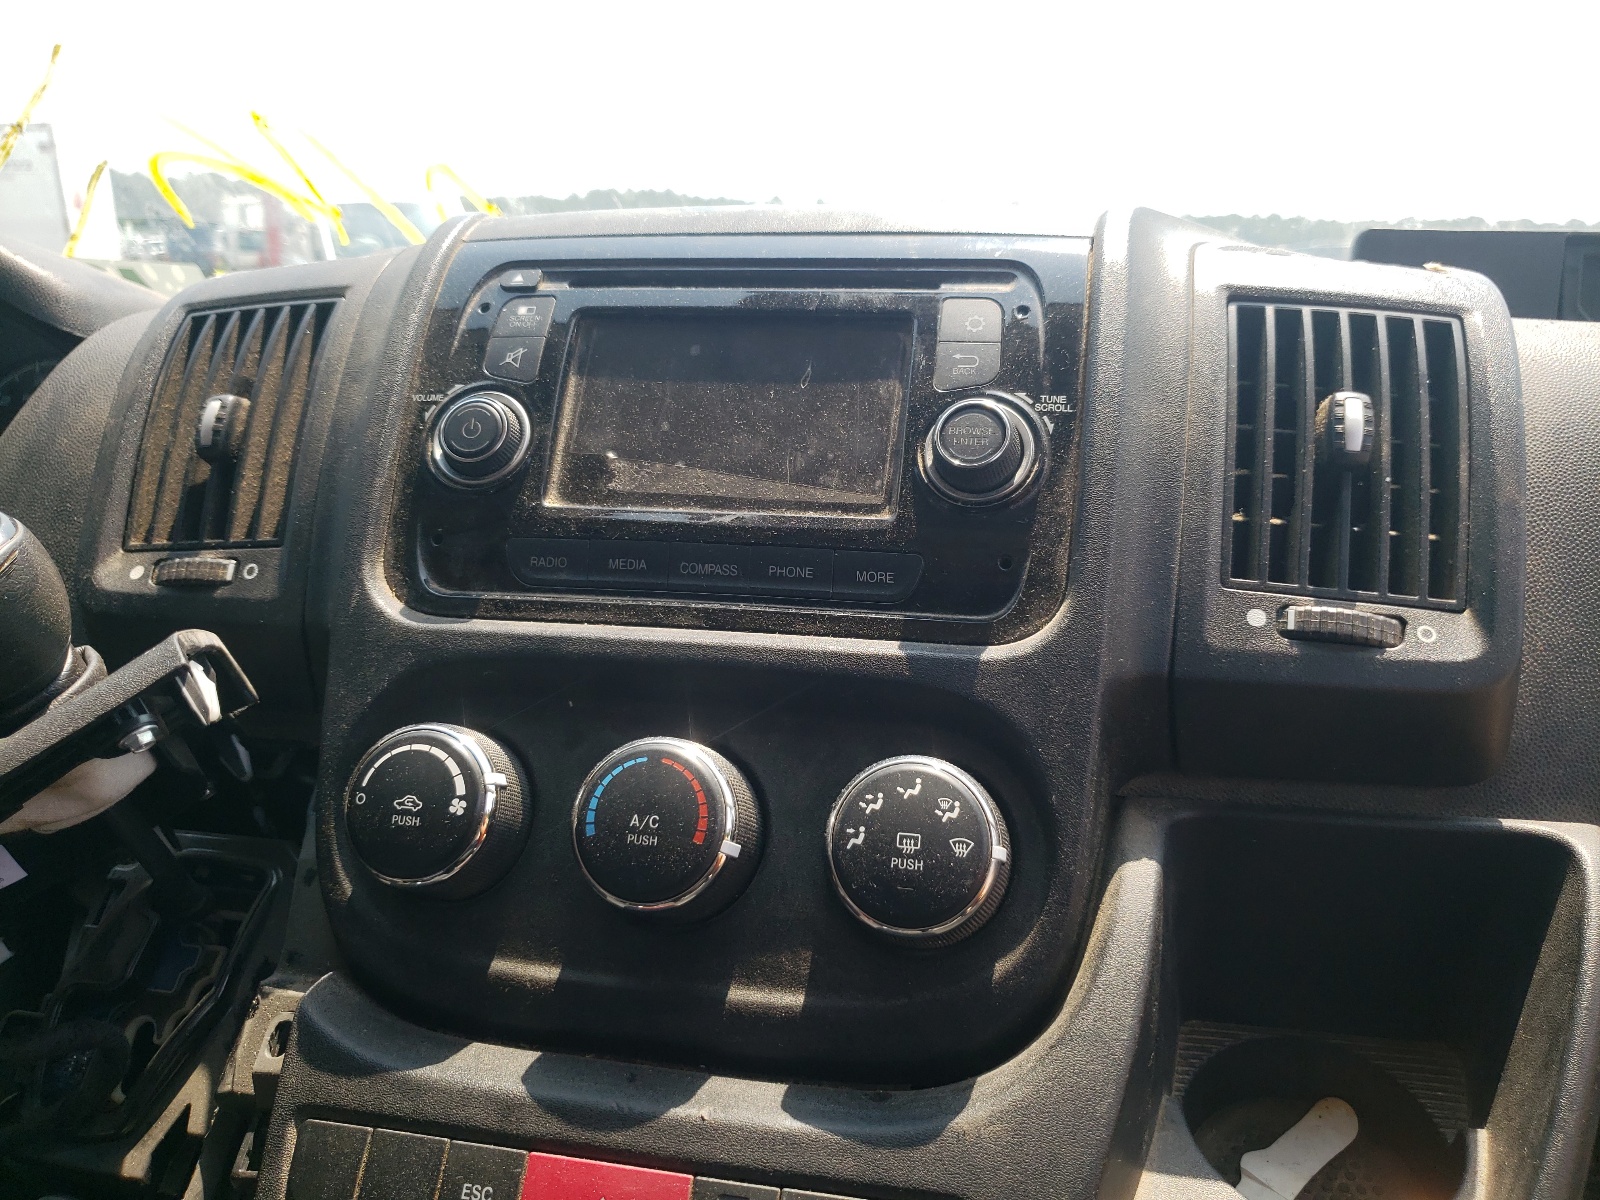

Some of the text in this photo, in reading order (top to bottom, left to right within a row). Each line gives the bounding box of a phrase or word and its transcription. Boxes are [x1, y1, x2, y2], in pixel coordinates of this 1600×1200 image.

[952, 367, 977, 375] BACK
[412, 394, 444, 402] VOLUME
[1040, 395, 1067, 404] TUNE
[1034, 404, 1073, 412] SCROLL
[948, 425, 995, 436] BROWSE
[530, 556, 567, 568] RADIO
[608, 558, 647, 571] MEDIA
[680, 562, 738, 576] COMPASS
[768, 565, 813, 579] PHONE
[856, 571, 894, 584] MORE
[391, 814, 420, 827] PUSH
[629, 813, 660, 829] A/C
[626, 833, 658, 847] PUSH
[890, 857, 924, 871] PUSH
[461, 1182, 494, 1200] ESC
